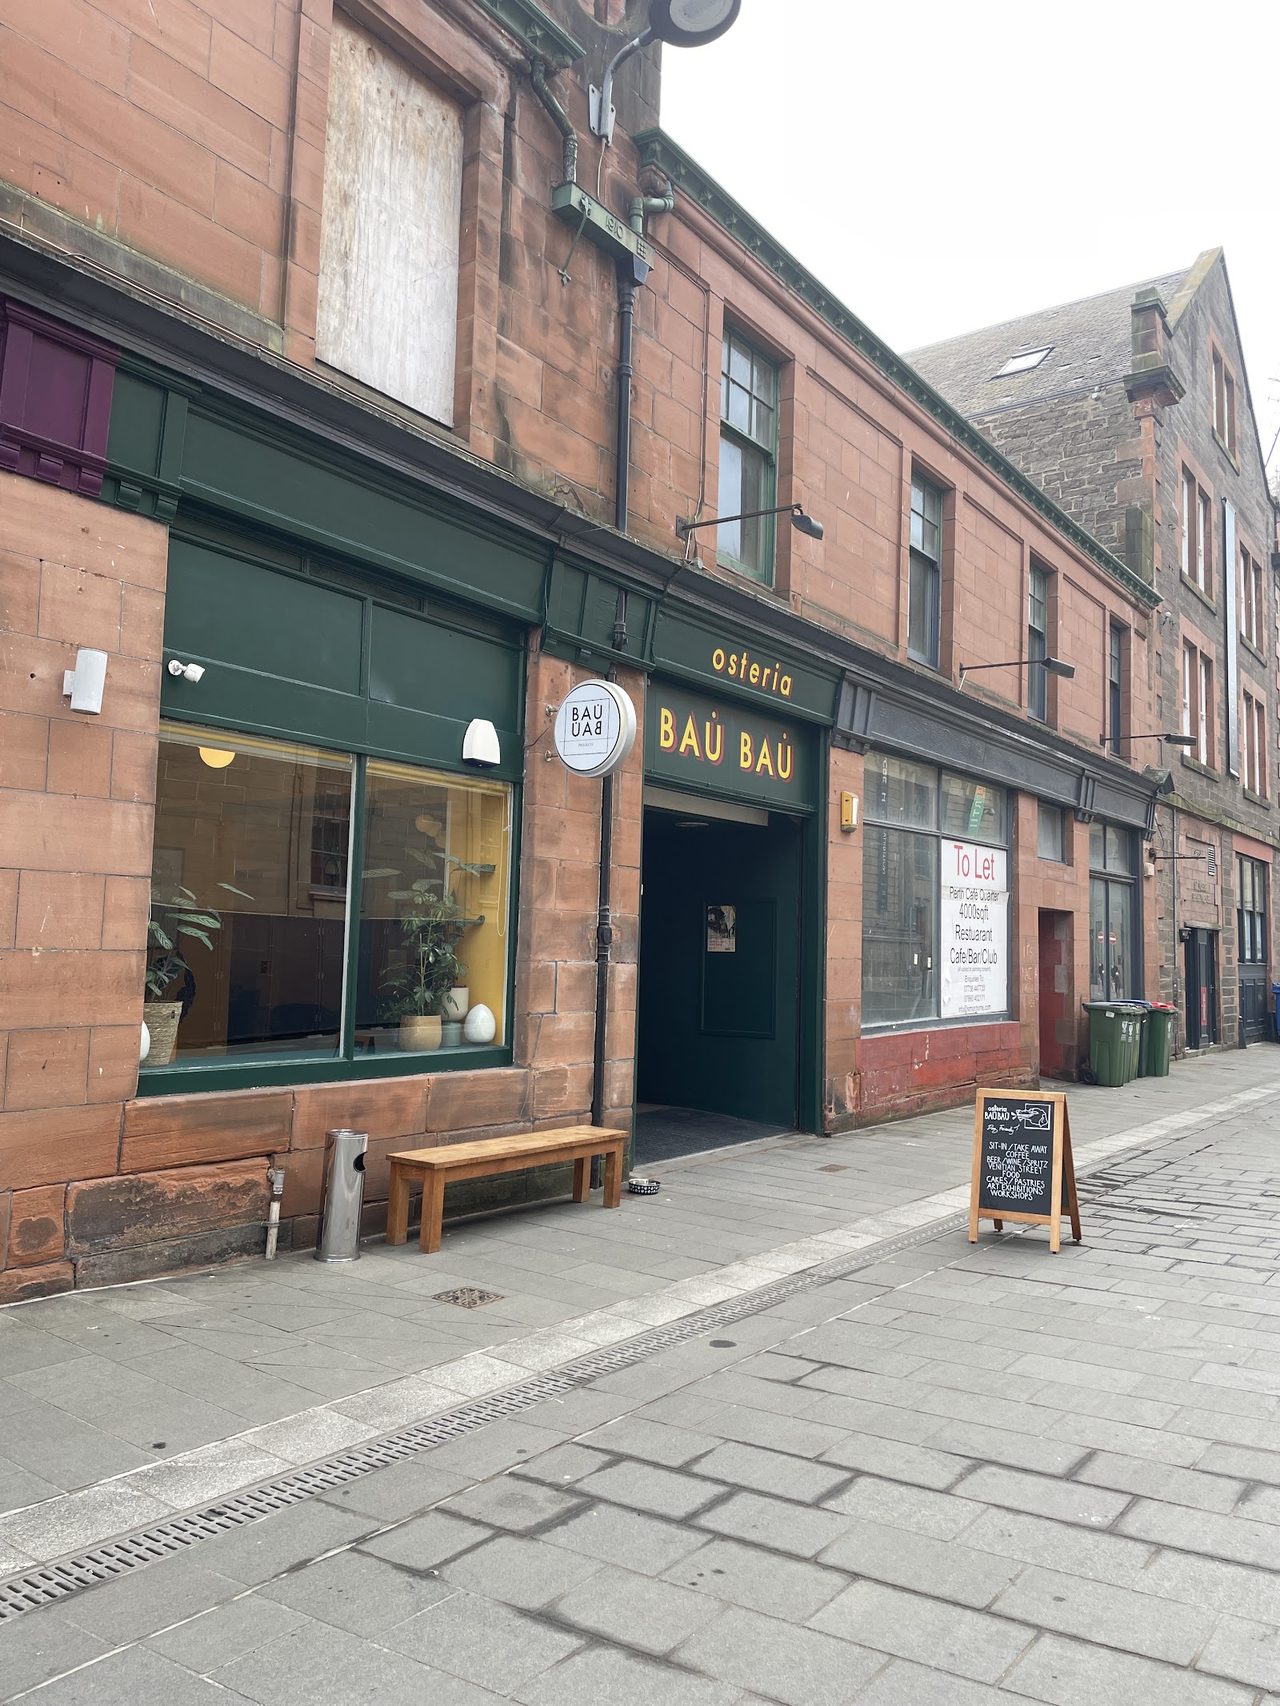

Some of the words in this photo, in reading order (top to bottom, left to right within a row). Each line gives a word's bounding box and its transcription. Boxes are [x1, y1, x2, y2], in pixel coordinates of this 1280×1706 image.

[712, 648, 793, 697] osteria
[954, 844, 970, 877] To
[975, 848, 995, 880] Let
[949, 886, 964, 899] Perth
[979, 888, 1000, 902] Quarter
[959, 903, 989, 923] 4000sqft
[1005, 1150, 1030, 1160] COFFEE
[1030, 1145, 1048, 1154] AWAY
[1002, 1170, 1021, 1178] FOOD
[1017, 1163, 1043, 1174] STREET
[986, 1182, 999, 1190] ART
[1001, 1183, 1044, 1196] EXHIBITIONS
[990, 1189, 1034, 1201] WORKSHOPS
